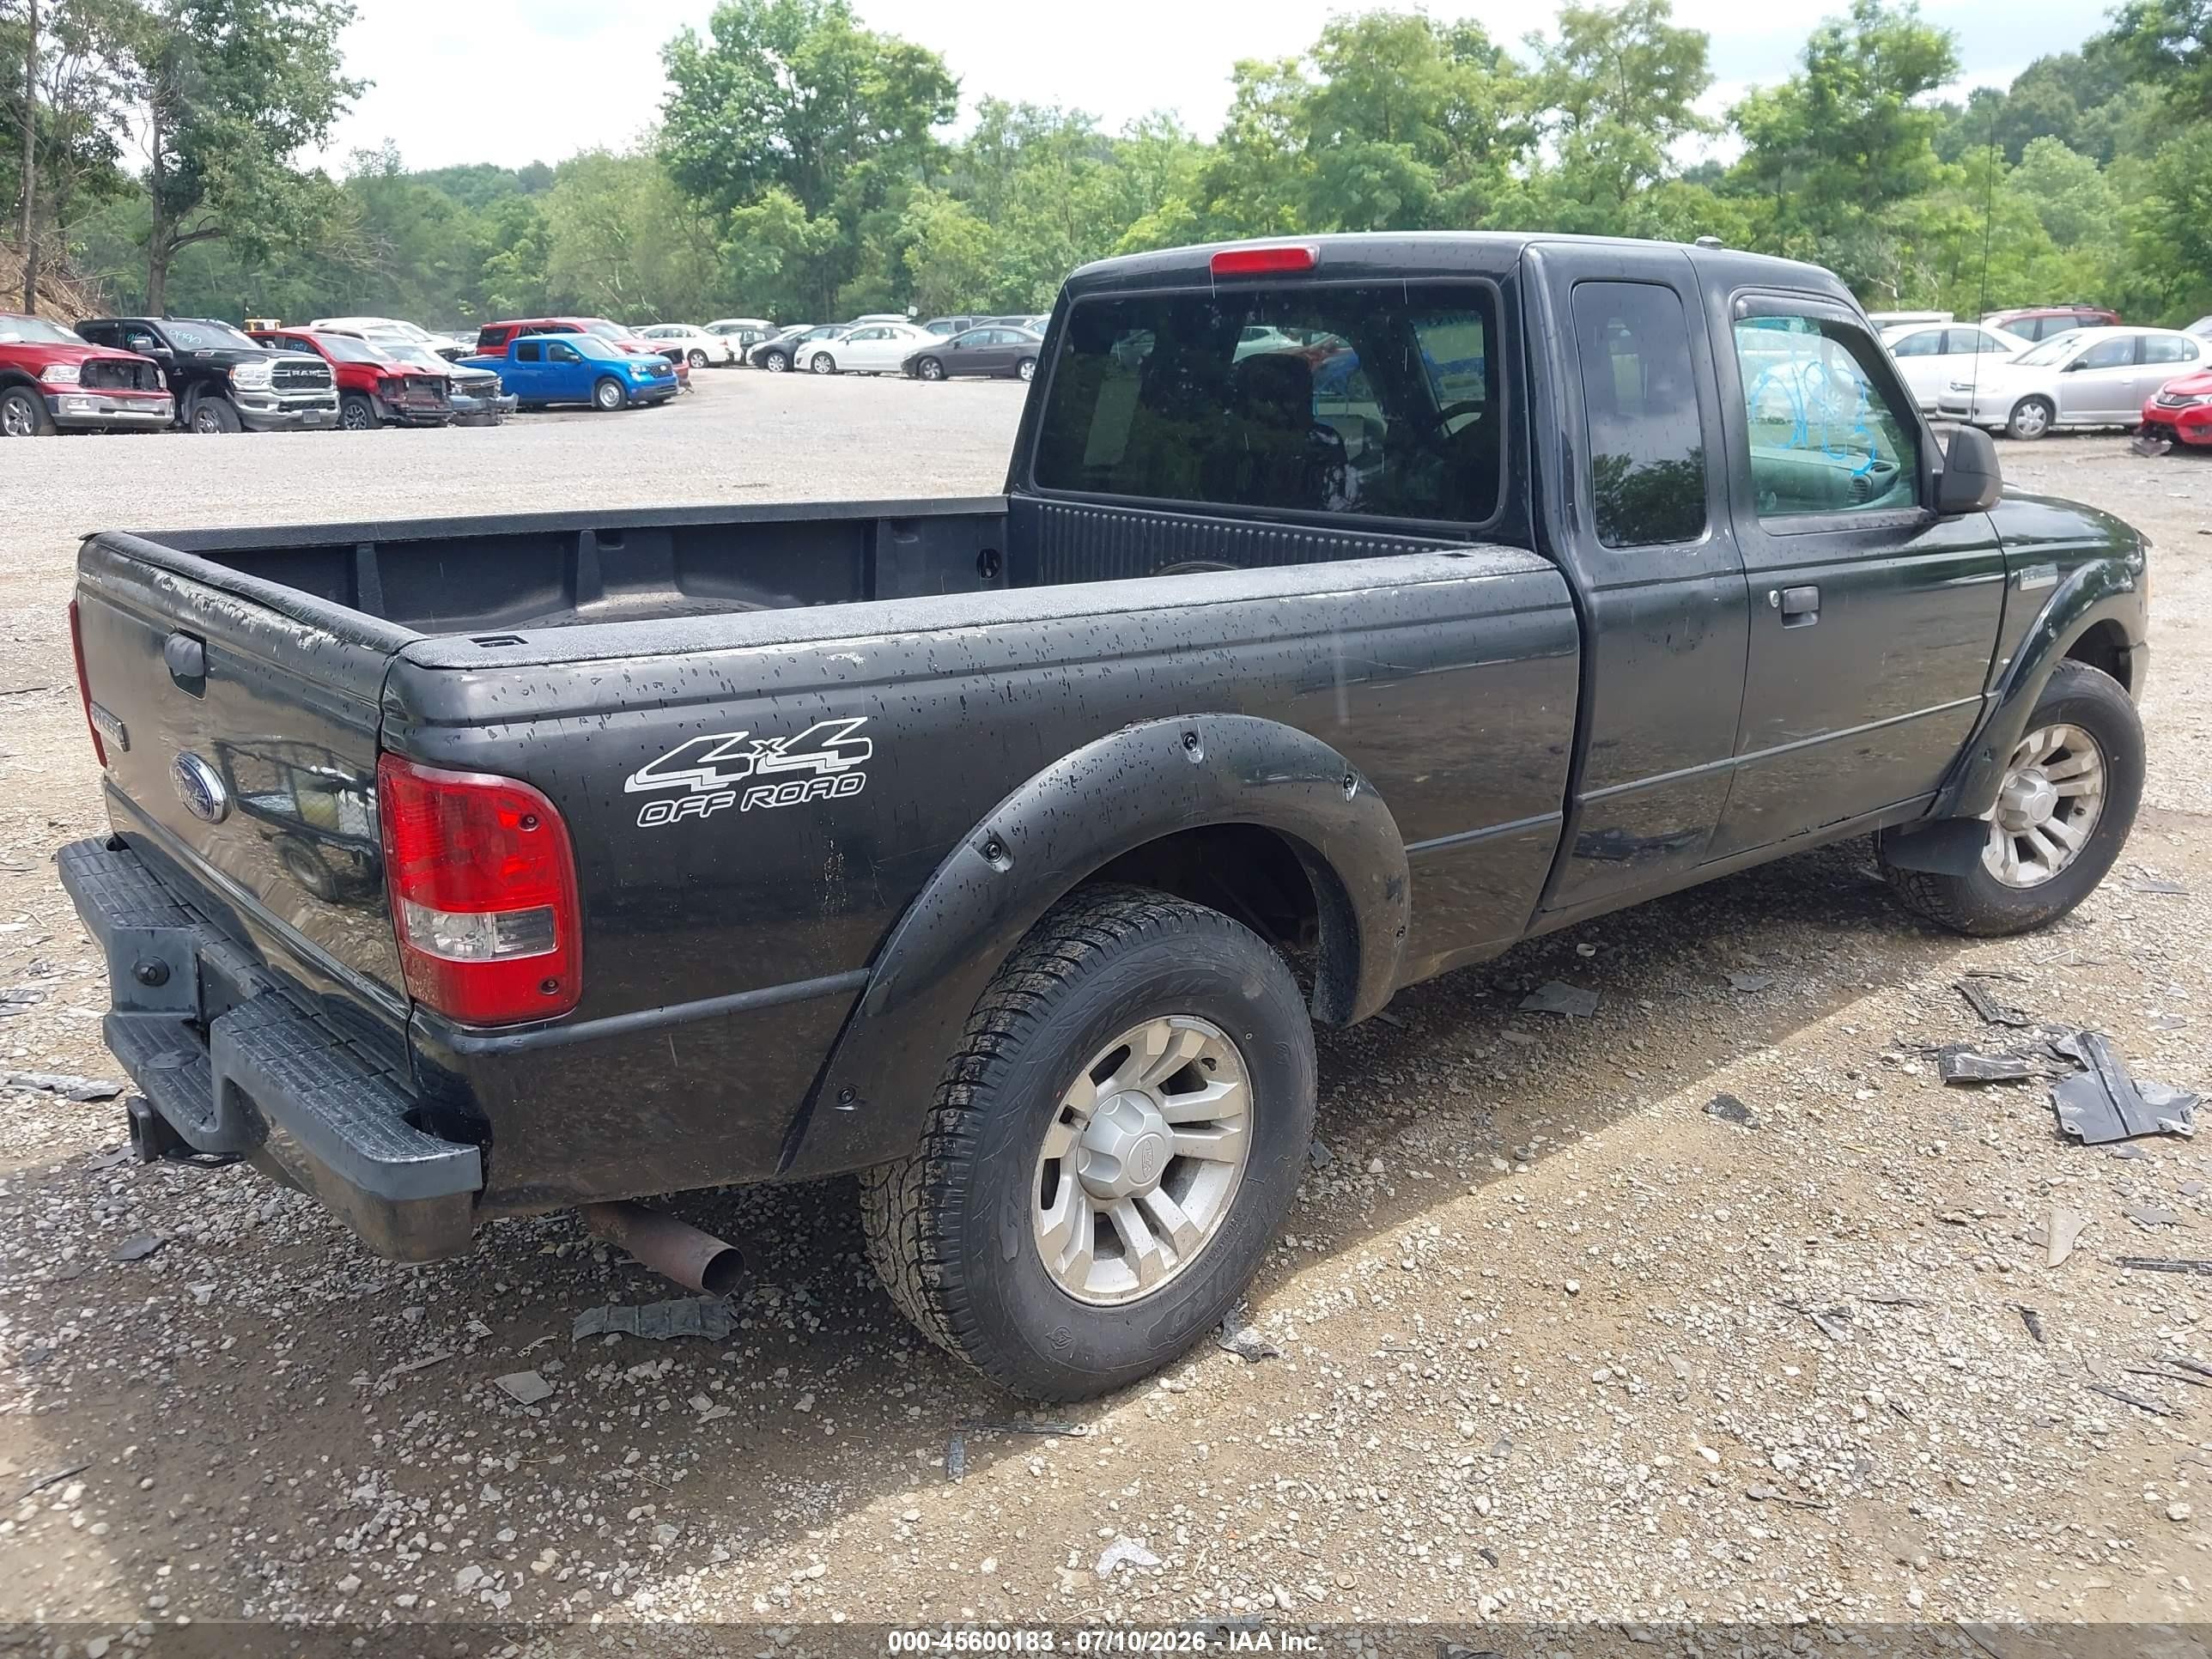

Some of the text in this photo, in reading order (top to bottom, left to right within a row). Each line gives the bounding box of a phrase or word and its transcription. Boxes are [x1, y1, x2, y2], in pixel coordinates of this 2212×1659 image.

[174, 766, 208, 811] Ford
[636, 771, 867, 828] OFF ROAD
